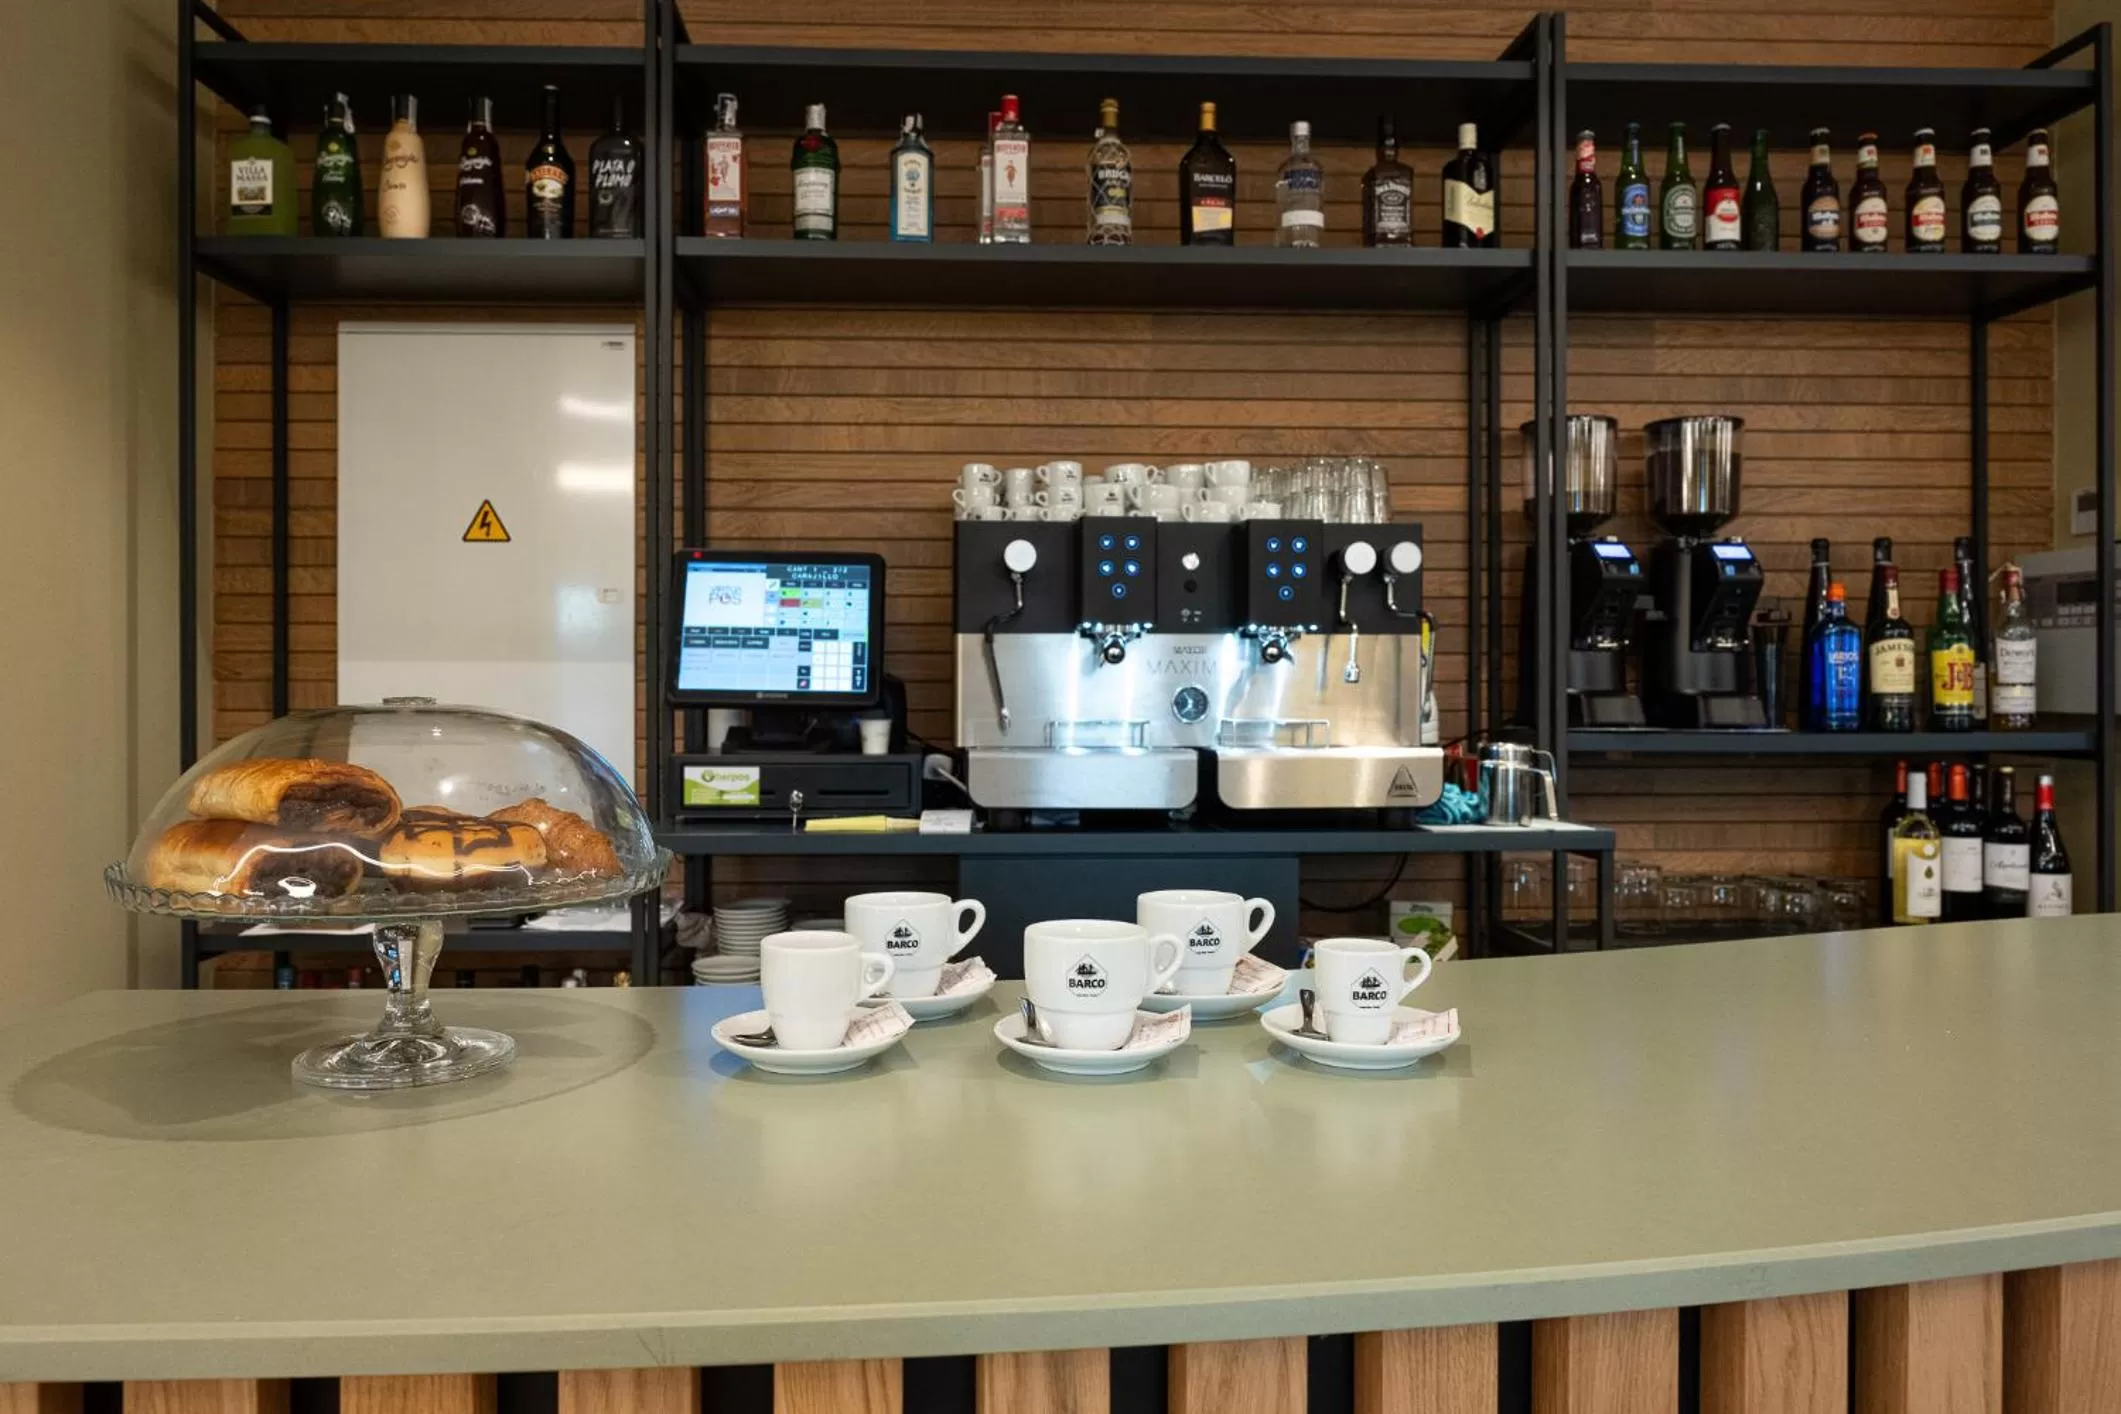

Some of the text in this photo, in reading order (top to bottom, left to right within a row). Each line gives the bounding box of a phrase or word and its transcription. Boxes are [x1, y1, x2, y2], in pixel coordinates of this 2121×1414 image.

[592, 159, 625, 174] PLATA
[595, 173, 632, 188] PLOMO
[887, 940, 919, 949] BARCO
[1189, 938, 1220, 947] BARCO
[1068, 978, 1105, 988] BARCO
[1352, 991, 1387, 1000] BARCO
